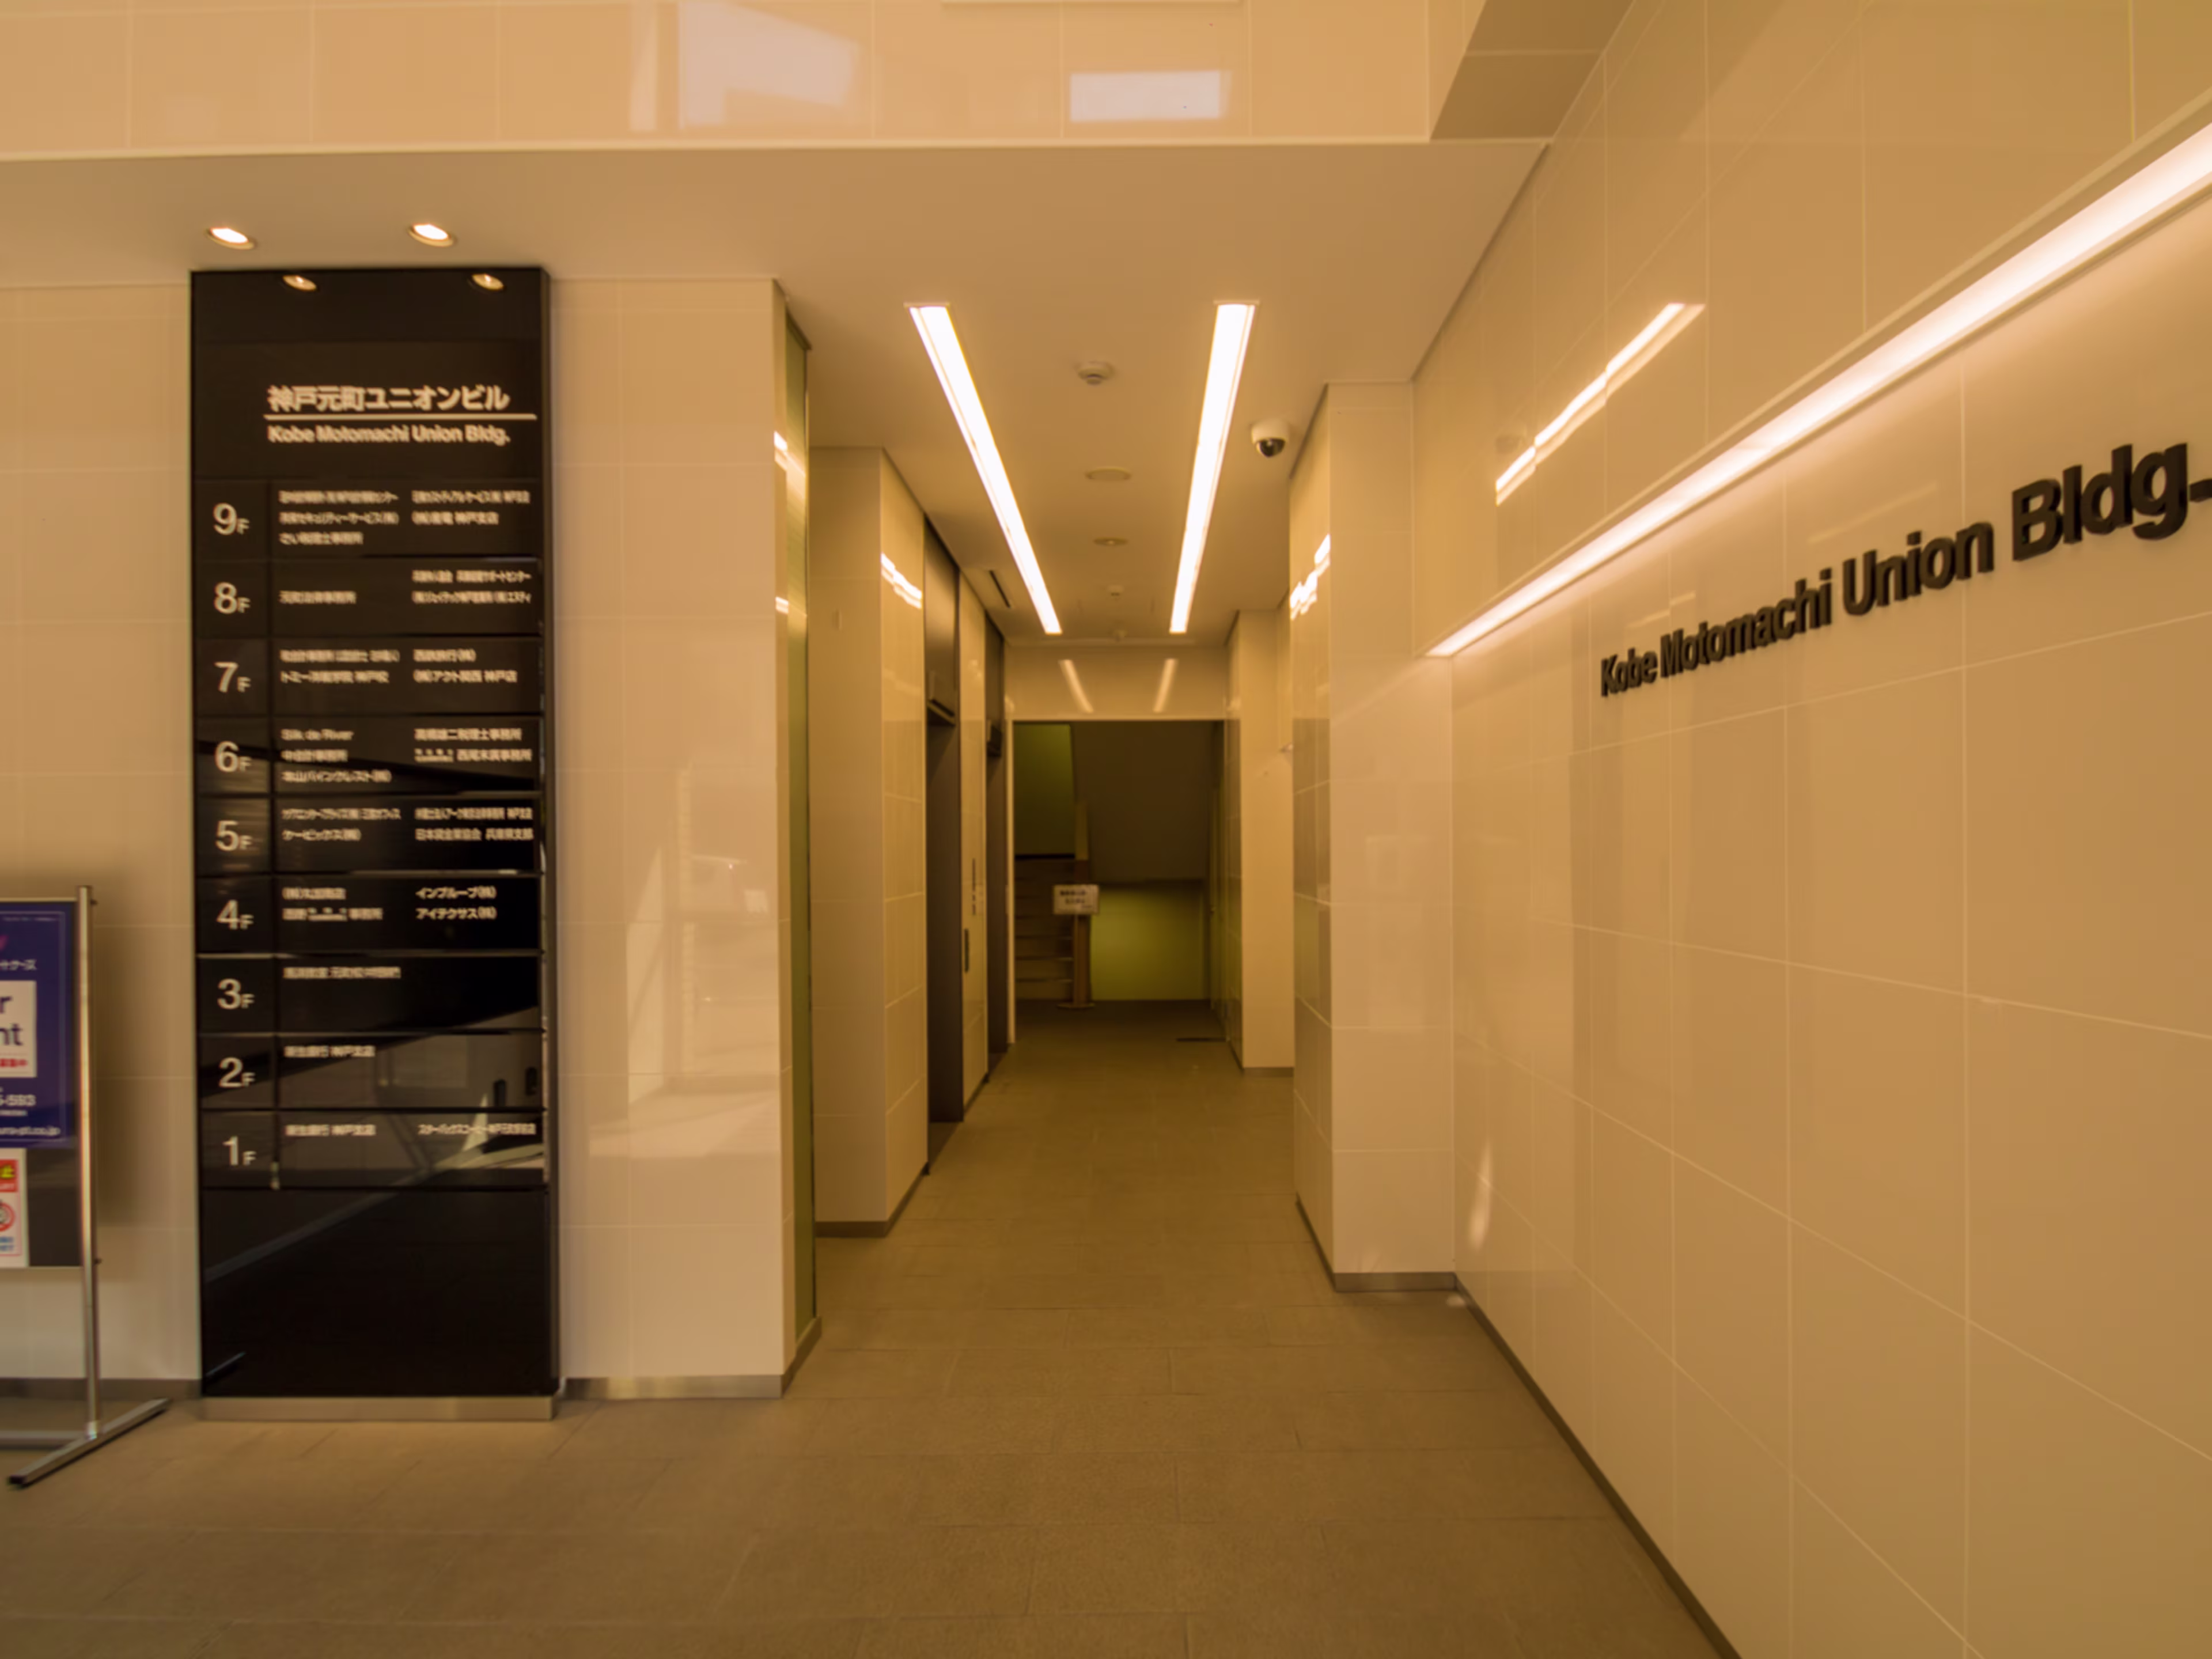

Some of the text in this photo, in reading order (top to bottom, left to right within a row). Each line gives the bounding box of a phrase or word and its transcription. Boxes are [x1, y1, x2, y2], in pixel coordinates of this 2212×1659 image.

[267, 385, 510, 412] 神戸元町ユニオンビル
[267, 425, 510, 446] Kobe Motomachi Union Bldg.
[1601, 649, 1657, 697] Kobe
[1660, 567, 1832, 679] Motomachi
[1842, 520, 1995, 616] Union
[214, 661, 251, 692] 7F
[215, 741, 251, 776] 6F
[216, 820, 253, 851] 5F
[217, 899, 253, 929] 4F
[218, 979, 253, 1009] 3F
[219, 1057, 253, 1088] 2F
[222, 1136, 257, 1165] 1F
